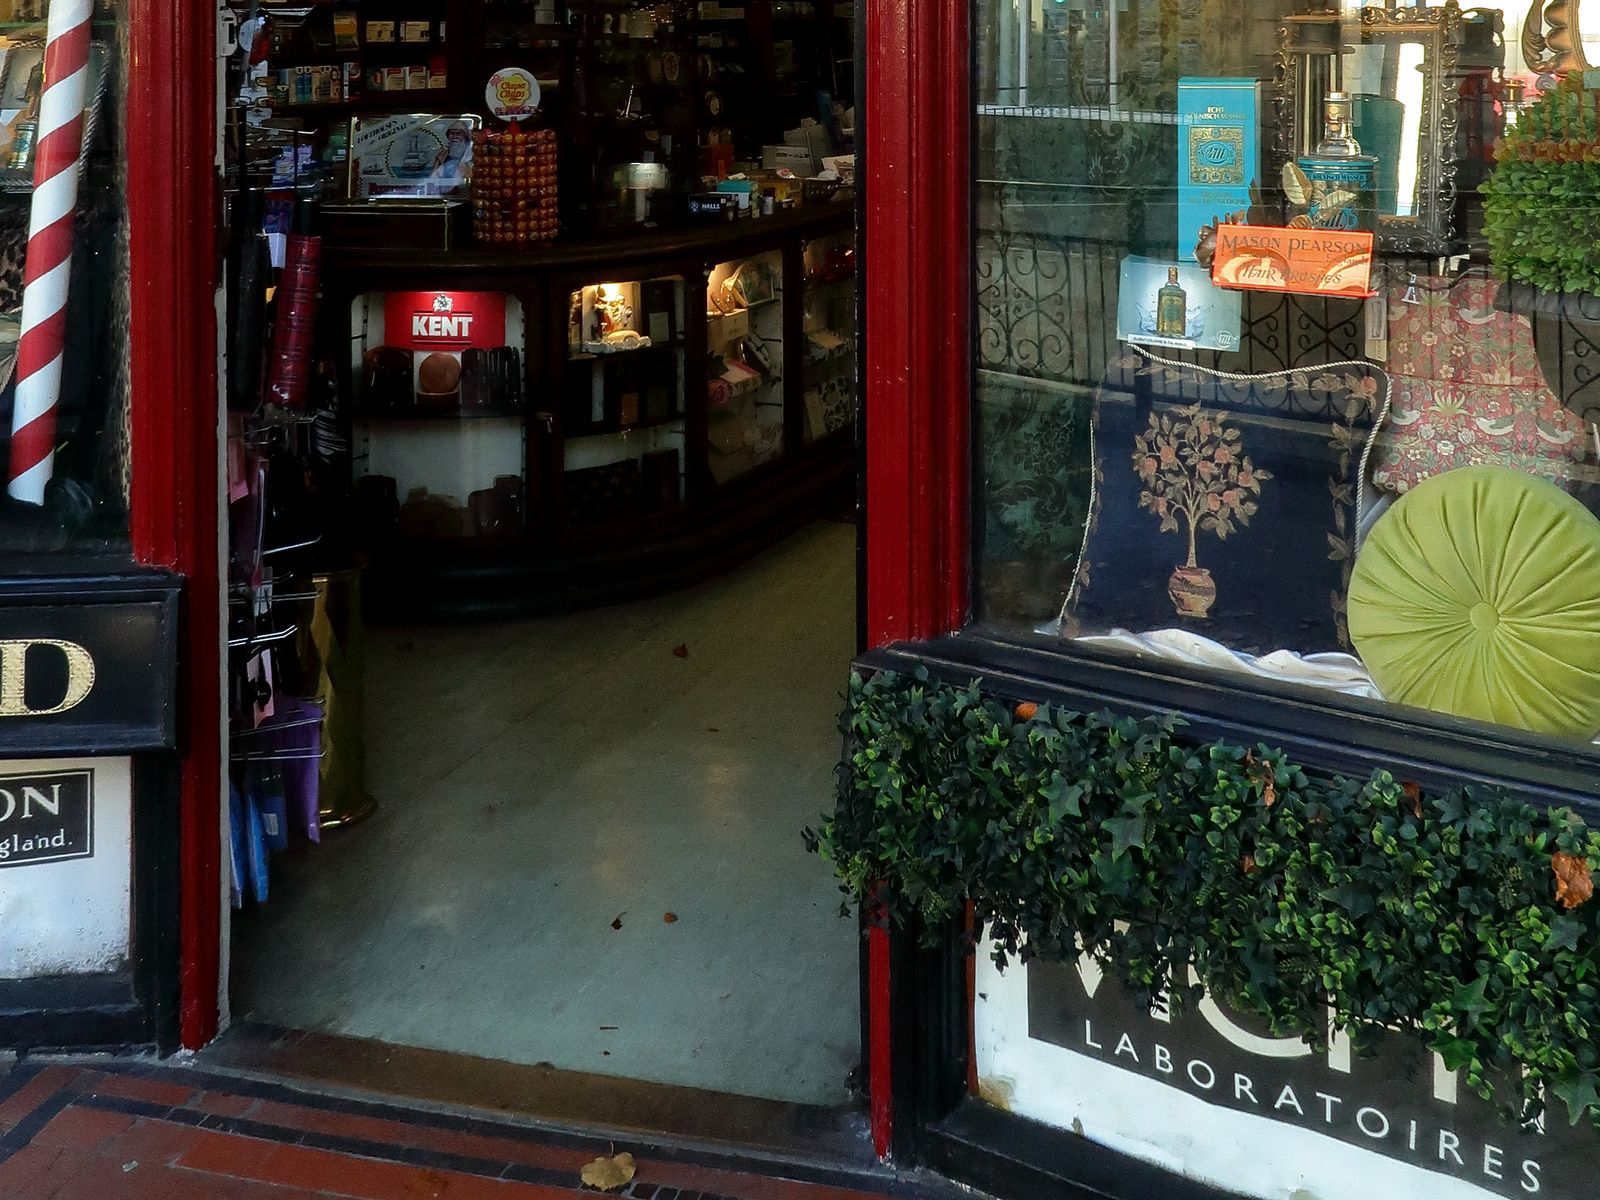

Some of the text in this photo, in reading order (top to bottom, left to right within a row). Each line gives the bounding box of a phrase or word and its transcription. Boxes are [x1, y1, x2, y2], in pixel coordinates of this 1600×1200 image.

[1221, 234, 1367, 261] MASON PEARSON
[412, 315, 473, 338] KENT
[1085, 1019, 1542, 1194] LABORATOIRES
